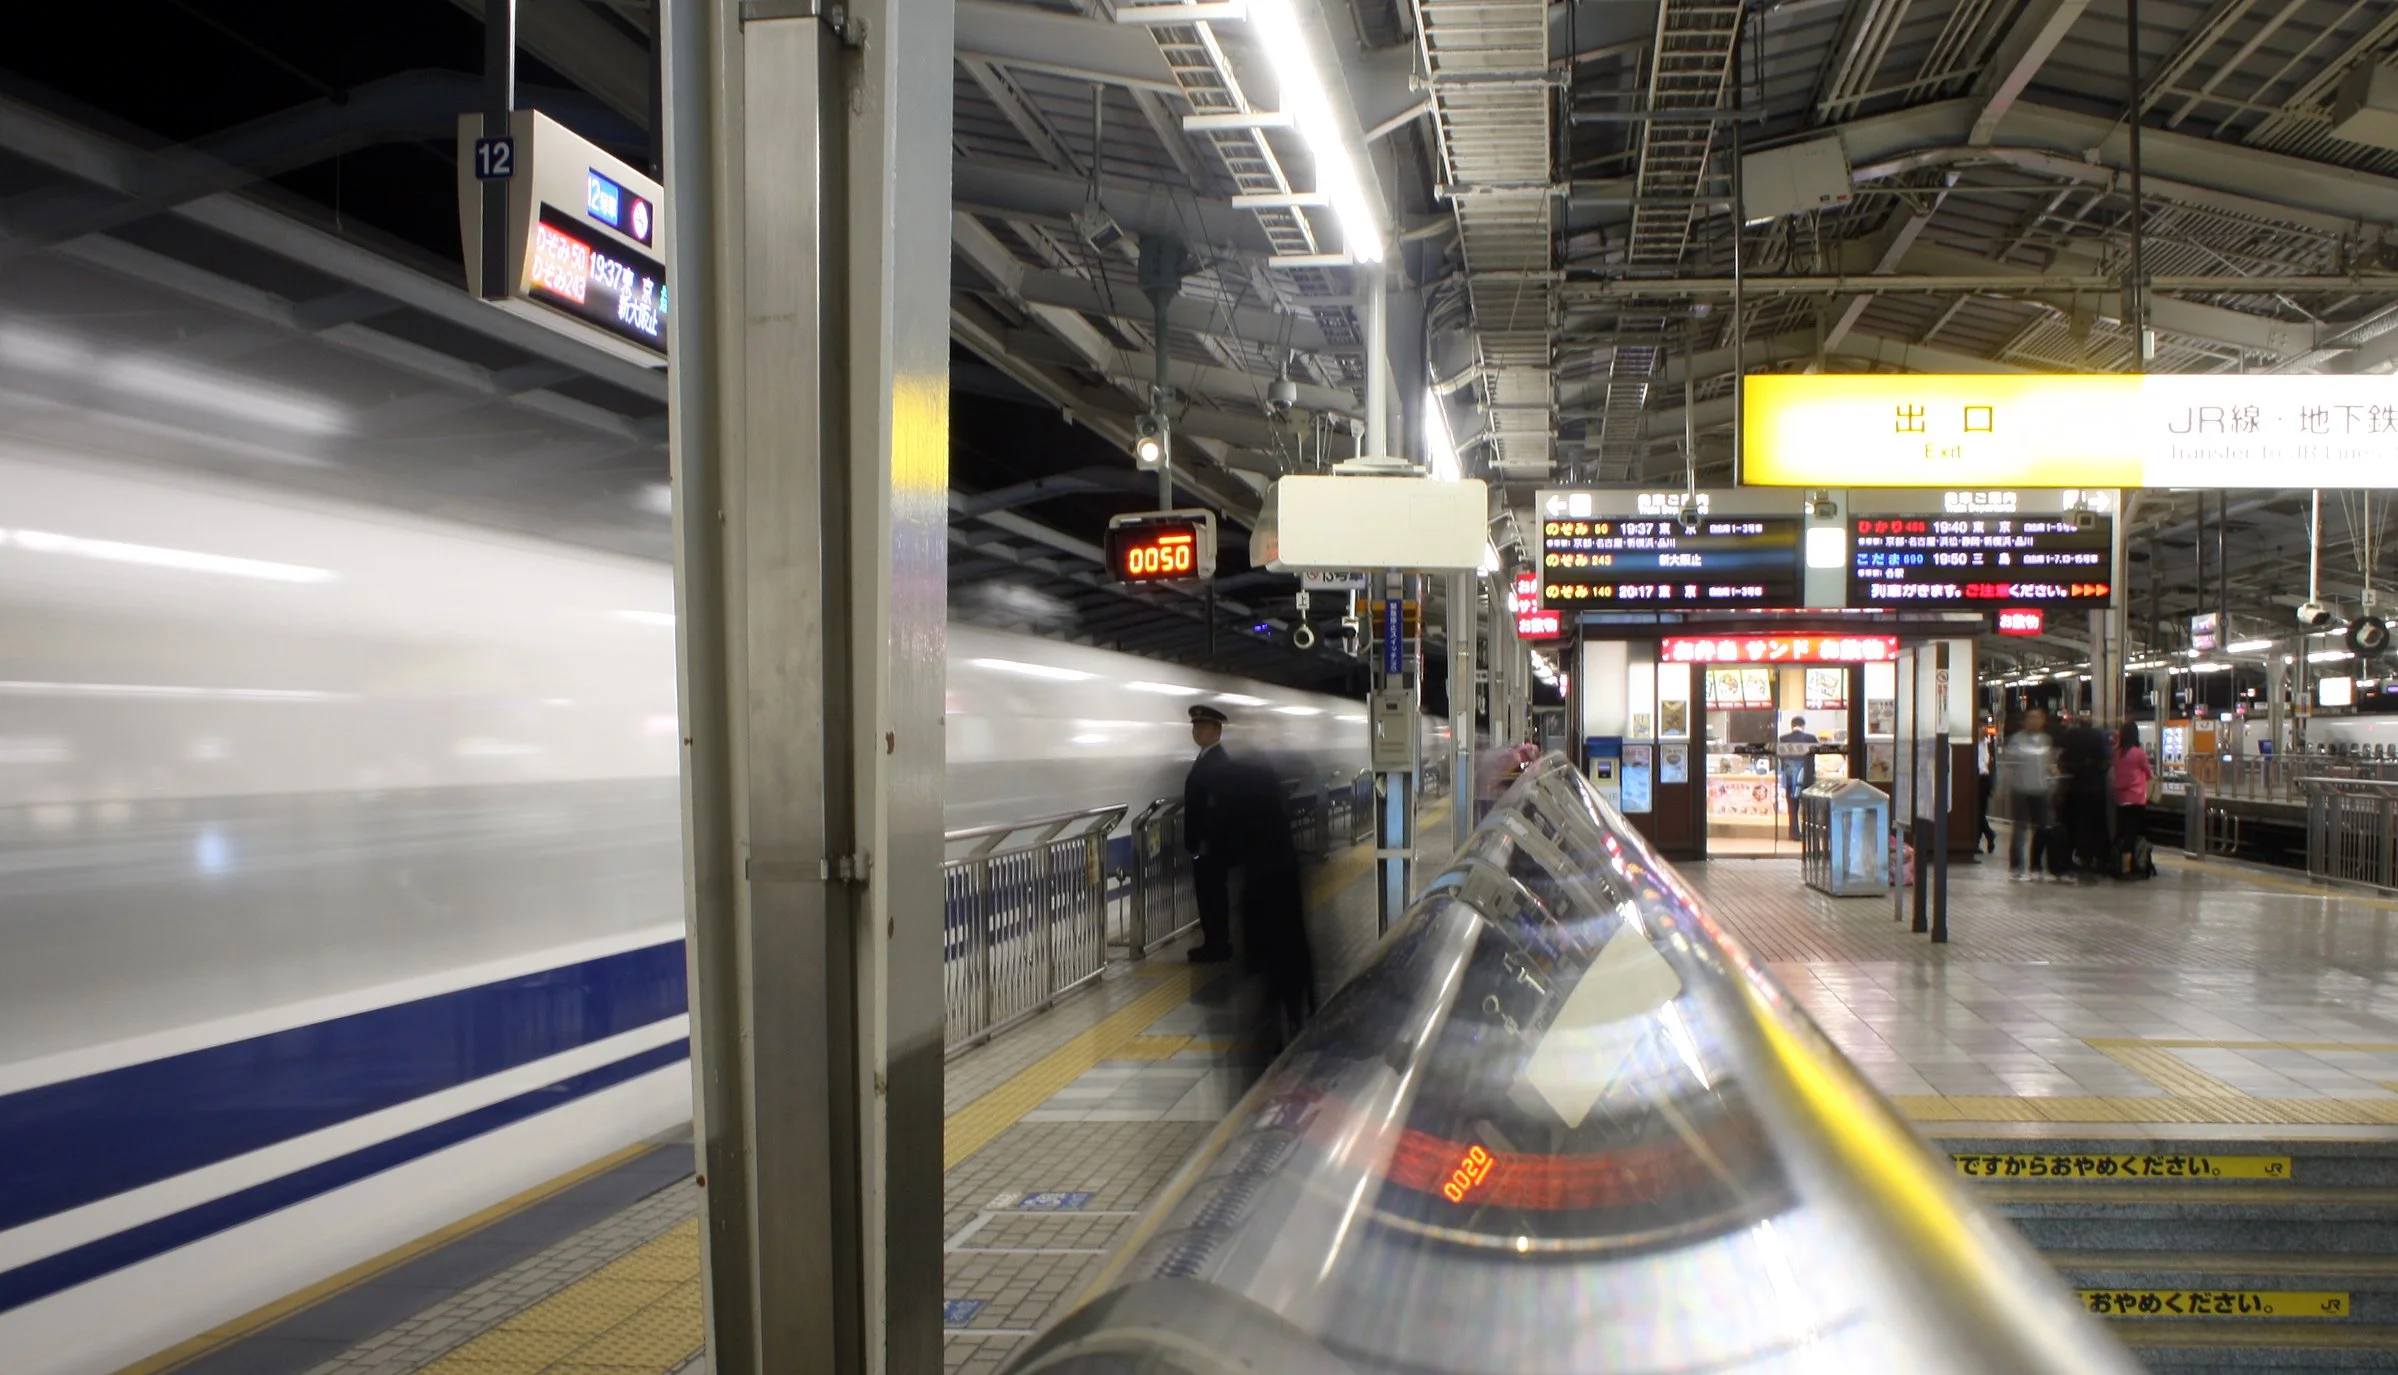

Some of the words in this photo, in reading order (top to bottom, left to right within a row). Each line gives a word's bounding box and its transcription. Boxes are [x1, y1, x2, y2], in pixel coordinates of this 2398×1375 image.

[479, 142, 510, 174] 12
[590, 251, 623, 290] 19:37
[1896, 402, 1994, 433] 出口
[1925, 443, 1962, 459] Exit
[1546, 523, 1588, 536] のぞみ
[1620, 523, 1653, 535] 19:37
[1858, 521, 1903, 534] ひかり
[1933, 521, 1968, 533] 19:40
[1129, 544, 1190, 574] 0050
[1546, 554, 1588, 567] のぞみ
[1591, 555, 1612, 566] 243
[1659, 554, 1702, 567] 新大阪止
[1857, 553, 1900, 566] こだま
[1933, 553, 1967, 566] 19:50
[1546, 586, 1588, 598] のぞみ
[1619, 586, 1653, 598] 20:17
[1746, 639, 1809, 660] サンド
